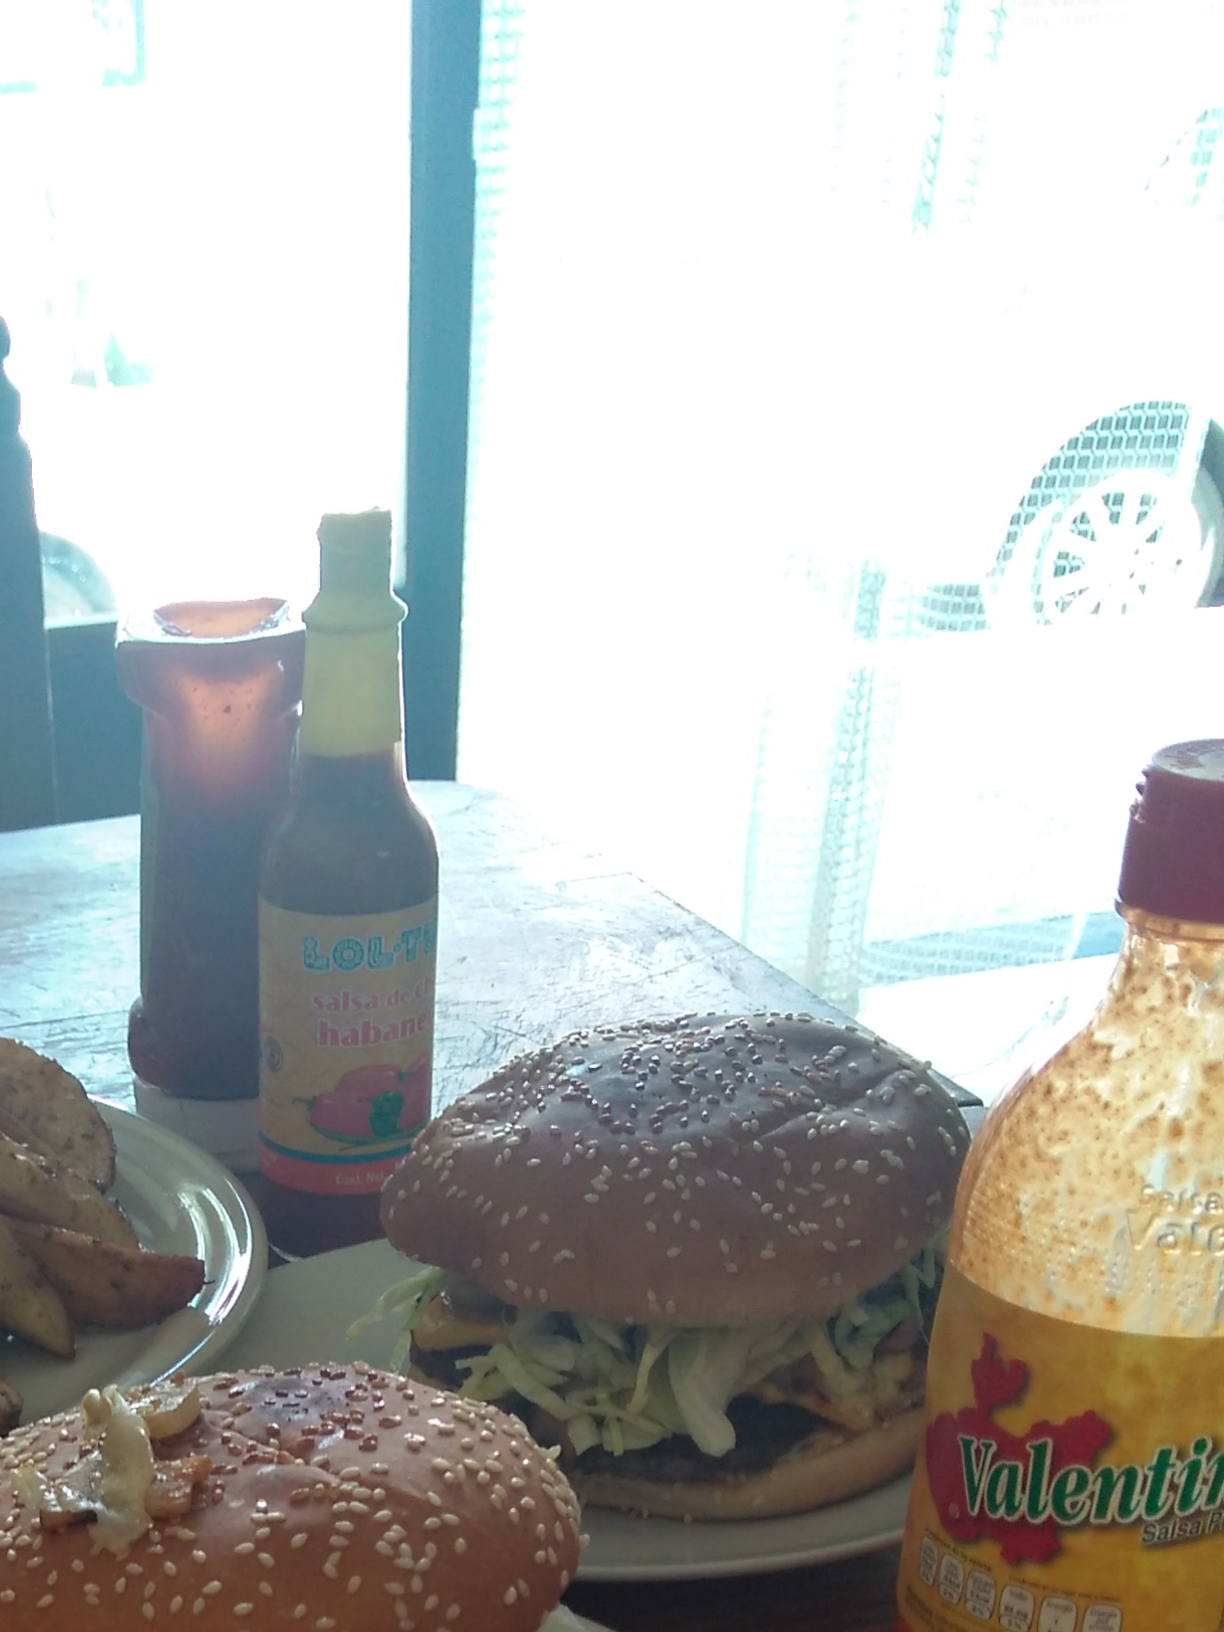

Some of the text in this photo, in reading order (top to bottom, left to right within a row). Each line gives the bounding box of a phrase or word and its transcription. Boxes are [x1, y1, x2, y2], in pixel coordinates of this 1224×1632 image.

[313, 989, 379, 1012] salsa
[386, 989, 412, 1006] de
[1140, 1518, 1203, 1545] Salsa
